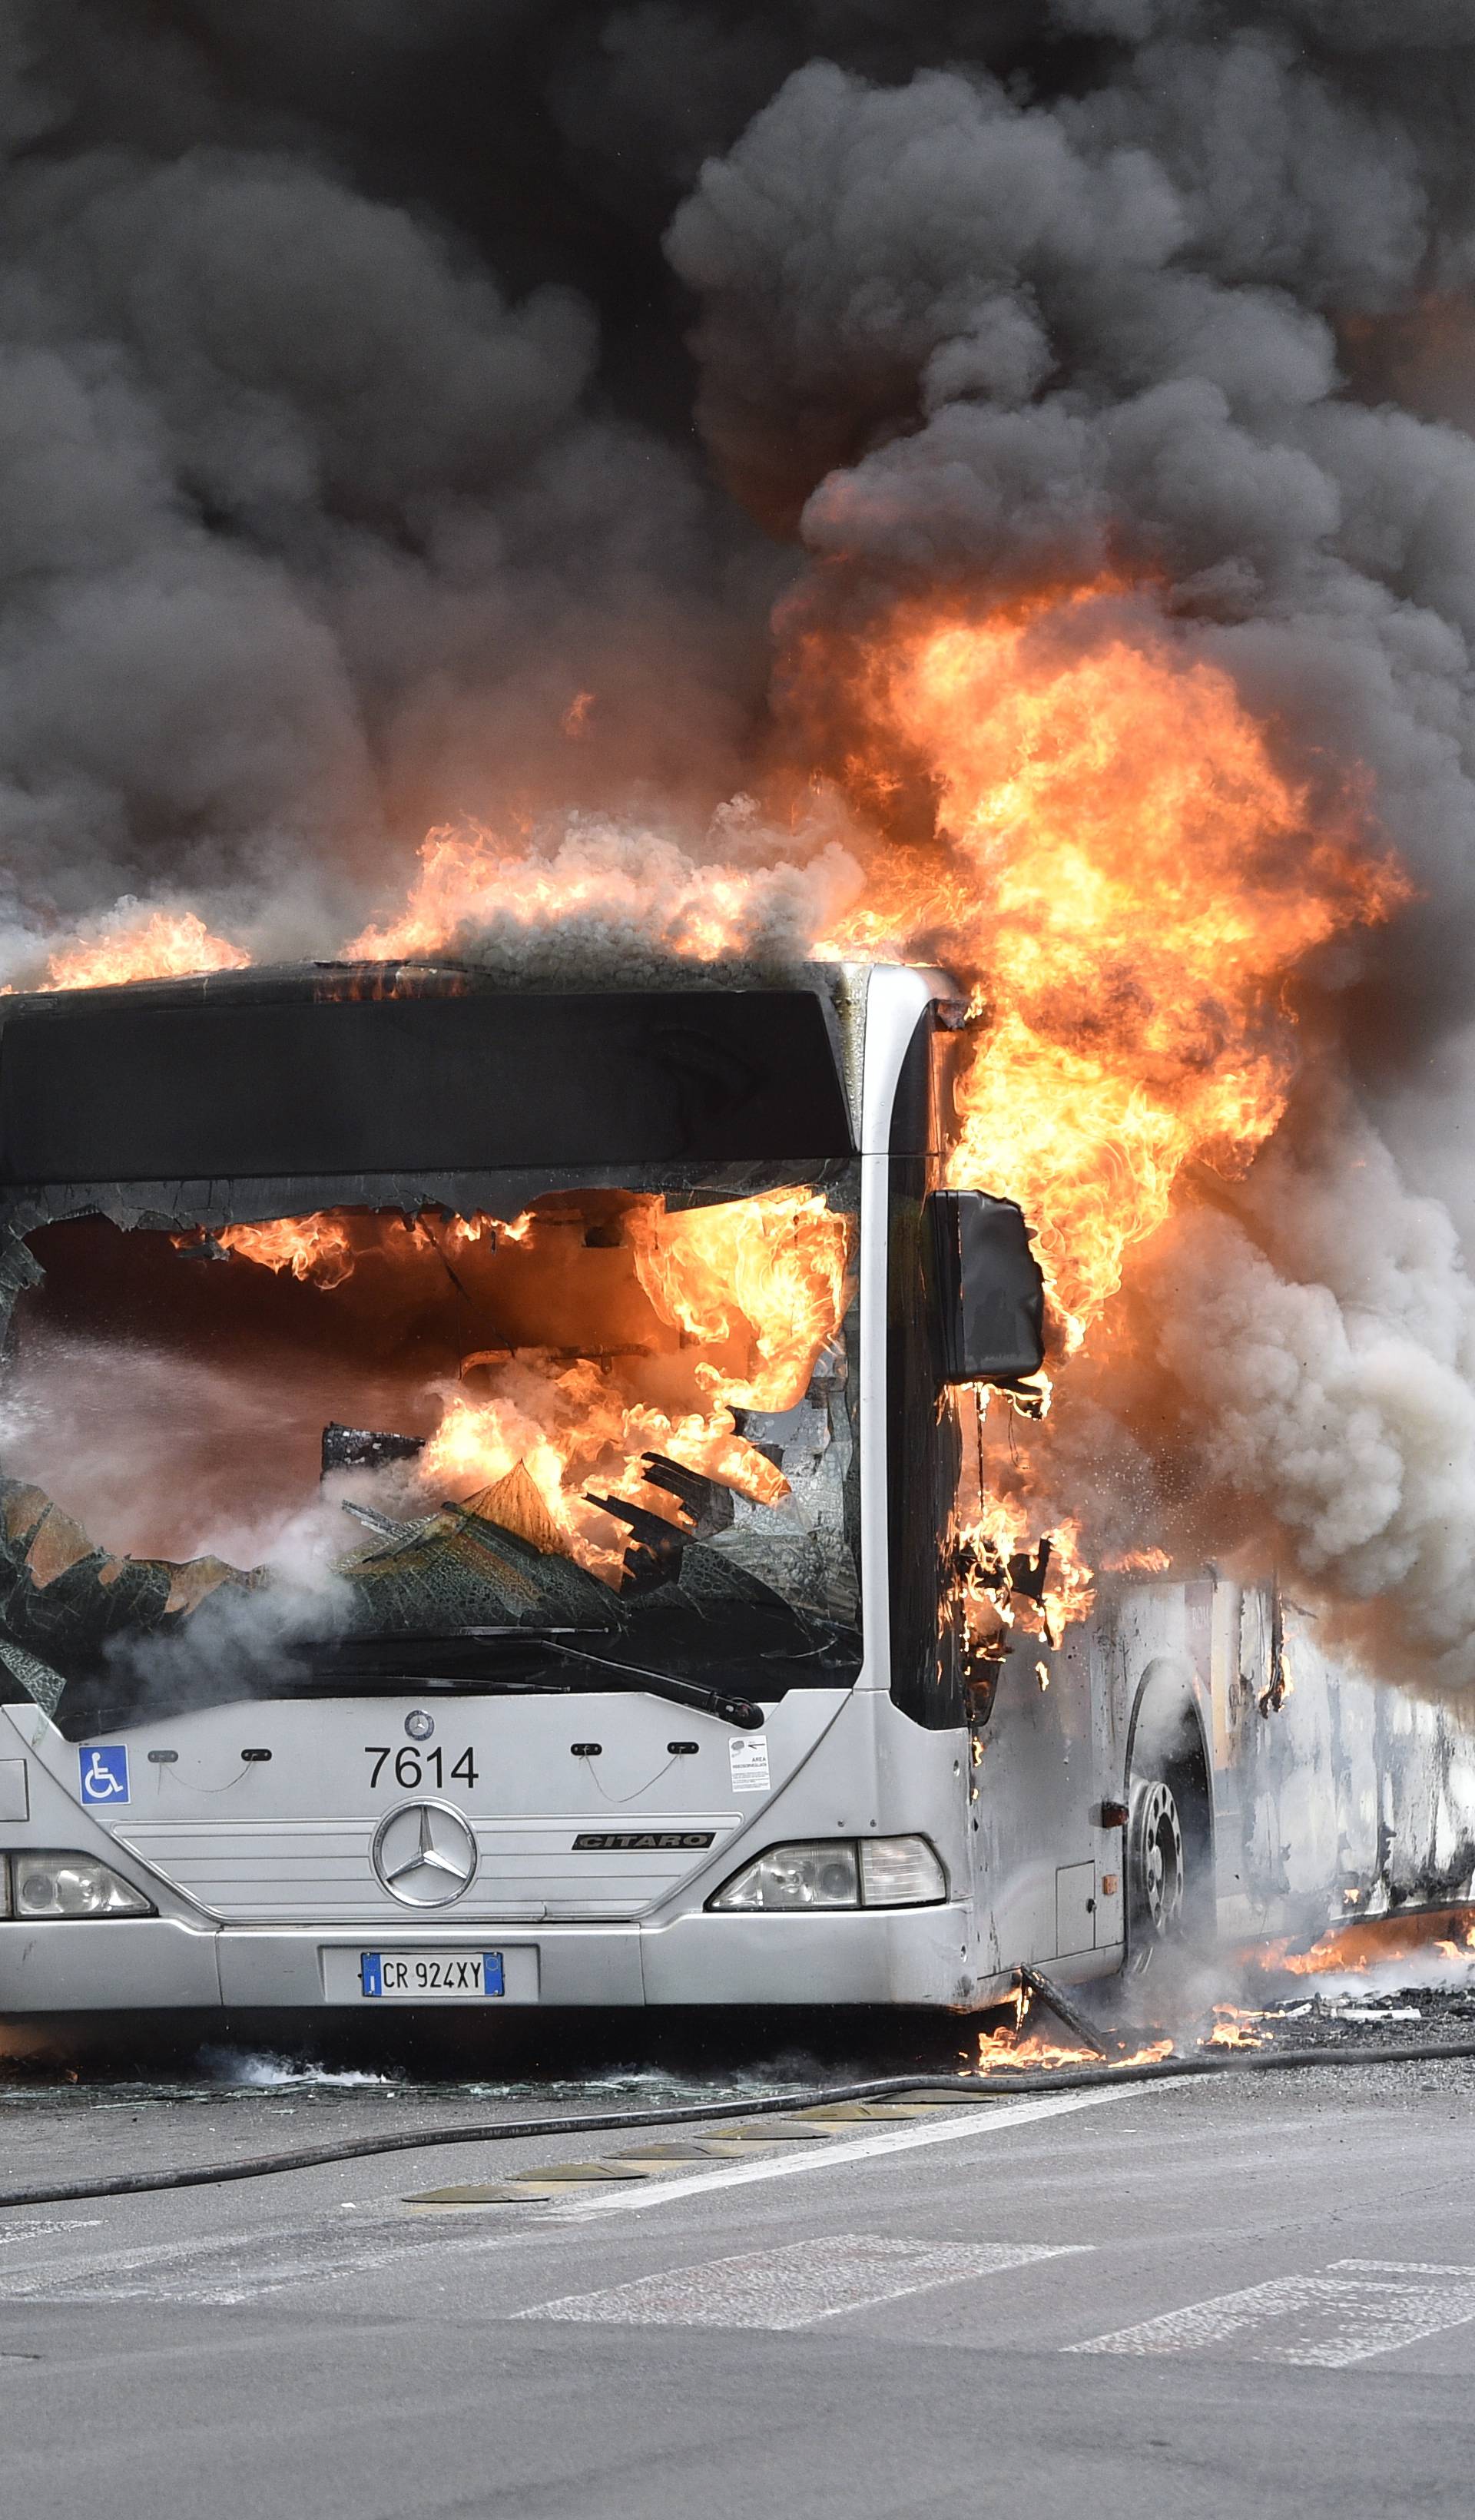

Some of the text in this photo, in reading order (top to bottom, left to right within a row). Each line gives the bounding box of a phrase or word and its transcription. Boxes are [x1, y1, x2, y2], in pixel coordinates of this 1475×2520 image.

[364, 1746, 479, 1789] 7614
[579, 1834, 708, 1848] CITARO
[383, 1961, 482, 1988] CR 924XY
